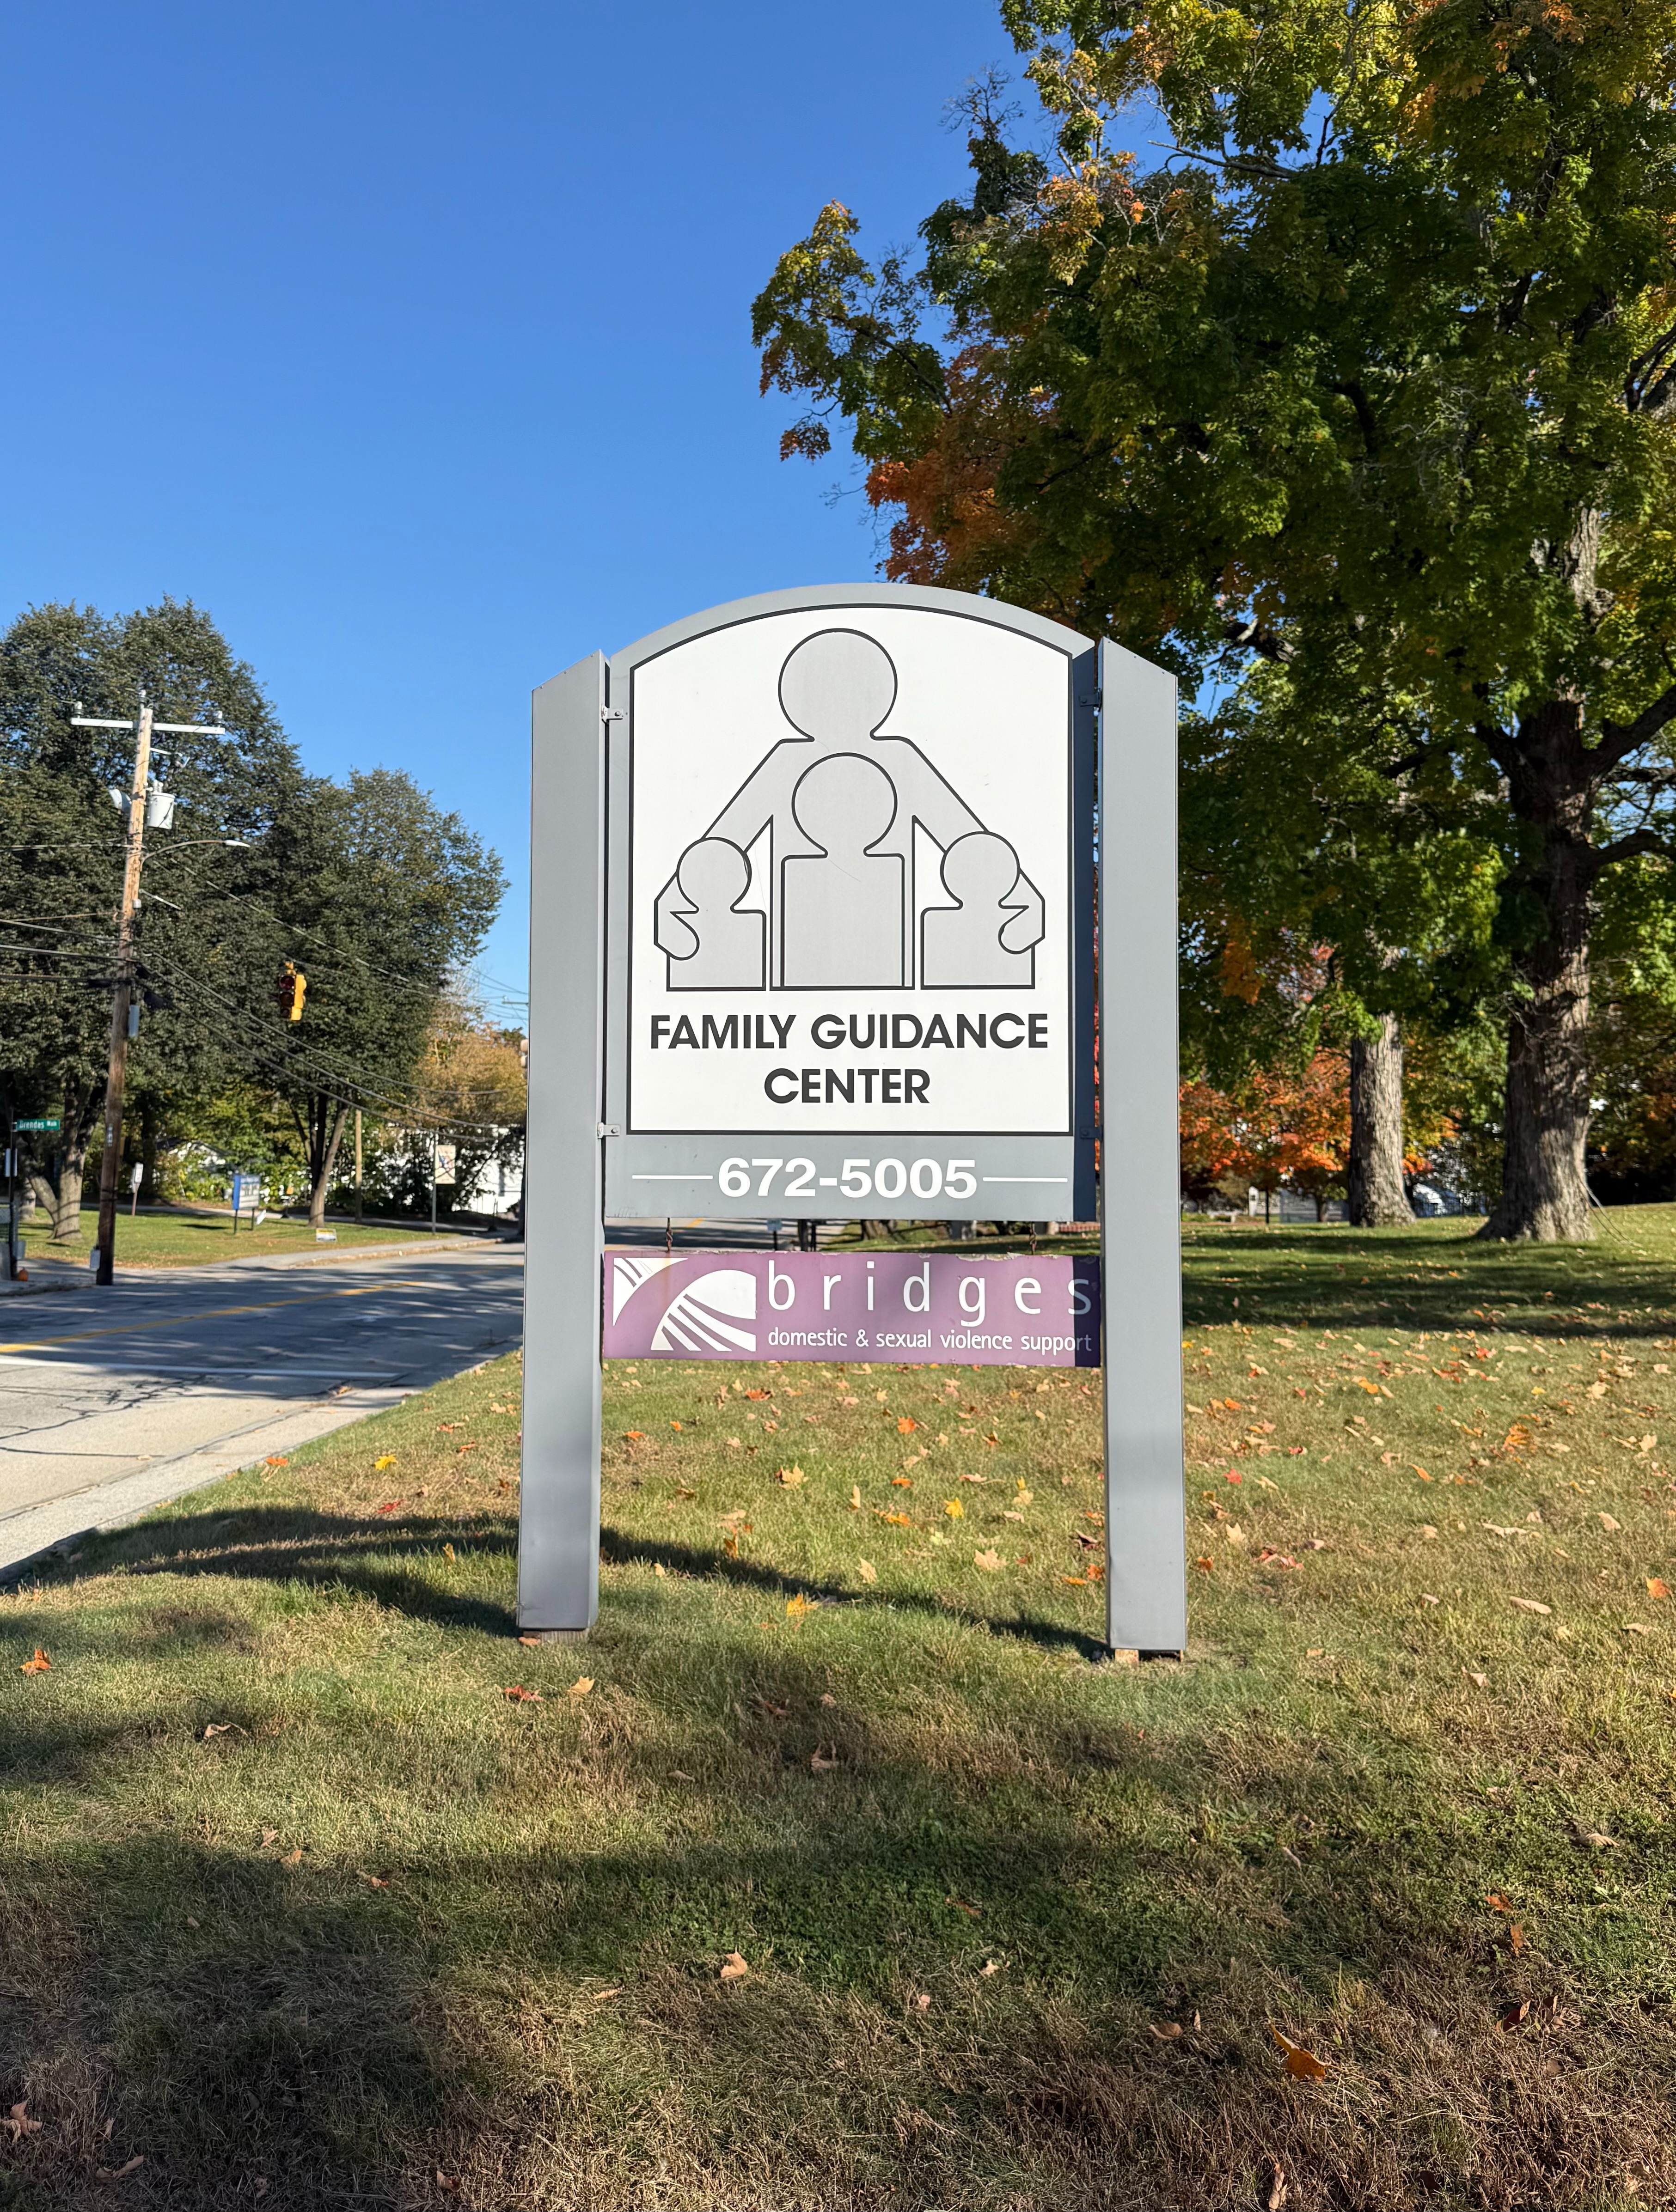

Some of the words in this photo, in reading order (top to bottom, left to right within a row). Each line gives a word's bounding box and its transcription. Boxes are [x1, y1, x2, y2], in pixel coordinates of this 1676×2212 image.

[651, 1014, 797, 1049] FAMILY
[811, 1012, 1048, 1049] GUIDANCE
[764, 1068, 930, 1104] CENTER
[718, 1157, 977, 1199] 672-5005
[768, 1260, 1091, 1328] bridges
[768, 1327, 847, 1347] domestic
[856, 1329, 869, 1347] &
[876, 1329, 931, 1348] sexual
[940, 1329, 1013, 1350] violence
[1021, 1334, 1092, 1356] support
